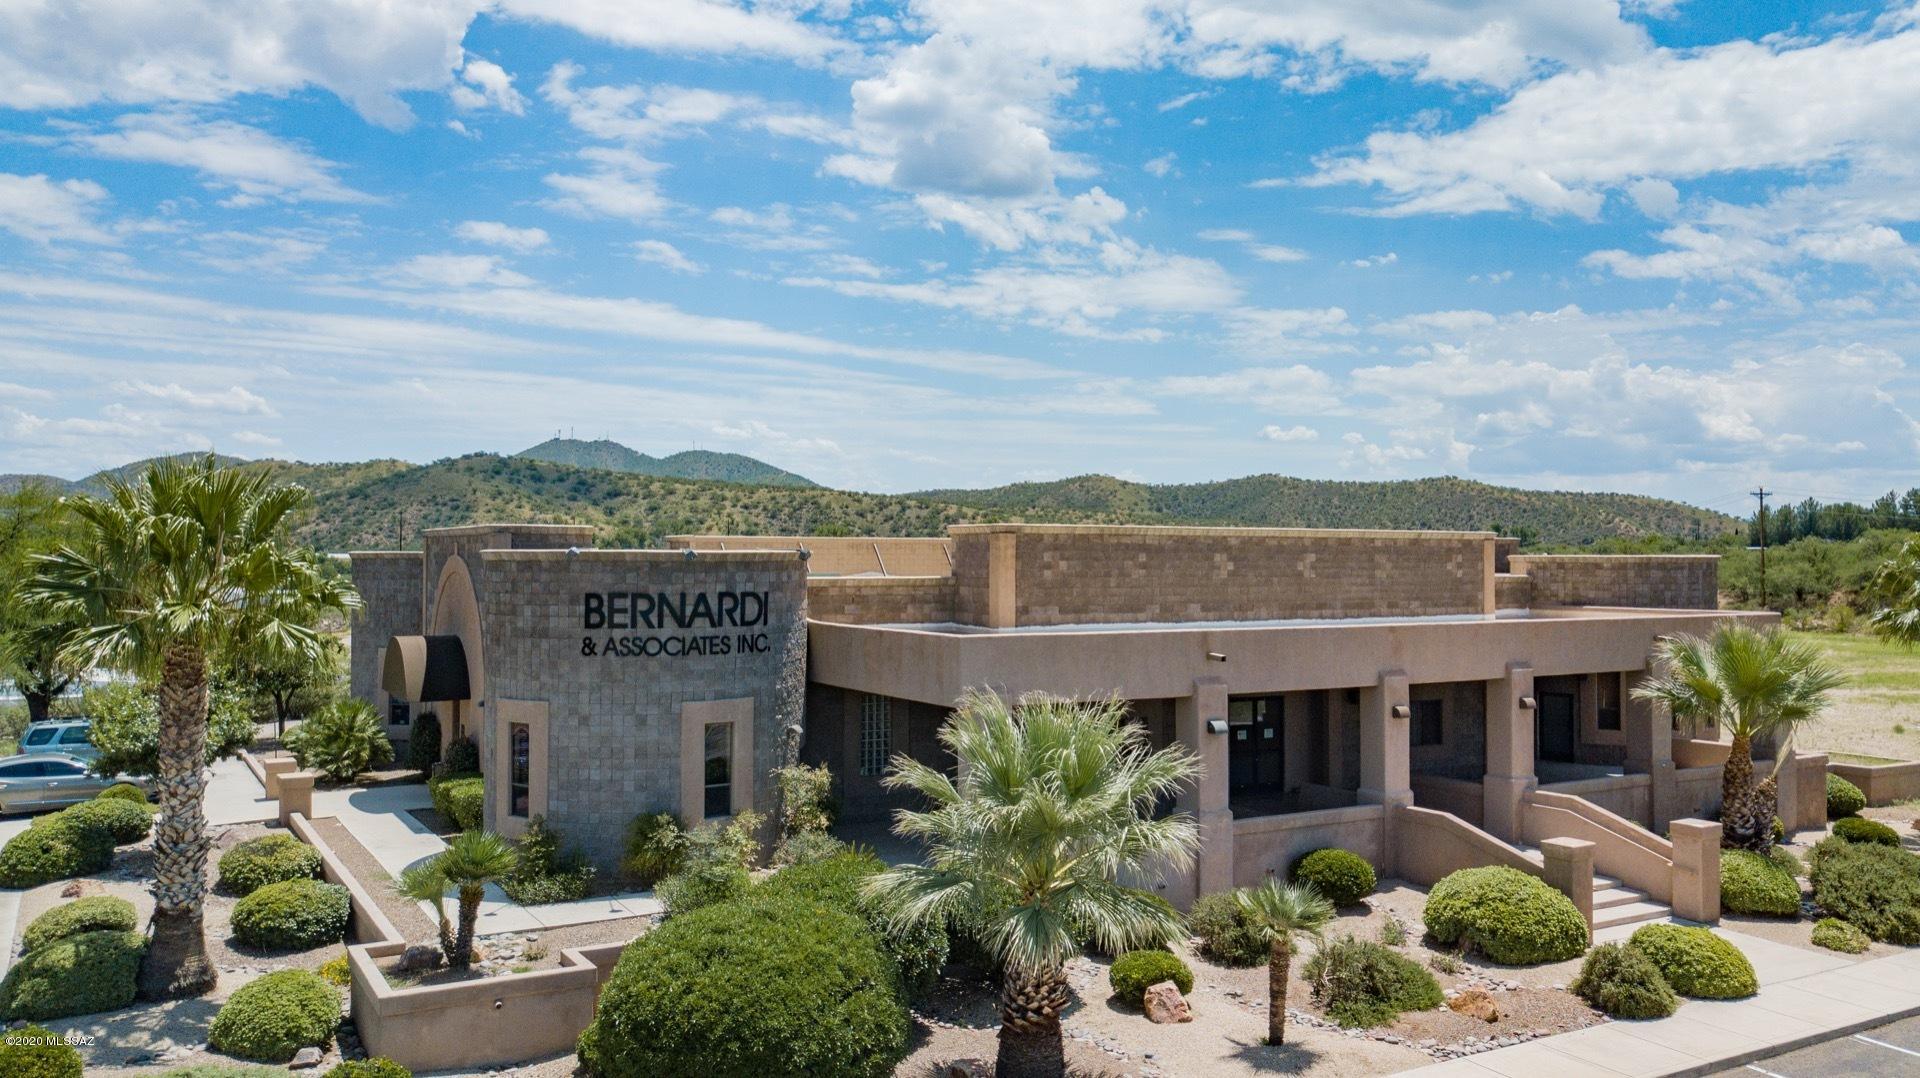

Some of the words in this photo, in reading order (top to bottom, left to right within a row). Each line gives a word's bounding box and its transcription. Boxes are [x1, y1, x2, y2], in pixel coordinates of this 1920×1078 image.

[584, 591, 769, 629] BERNARDI
[581, 636, 597, 657] &
[602, 635, 731, 657] ASSOCIATES
